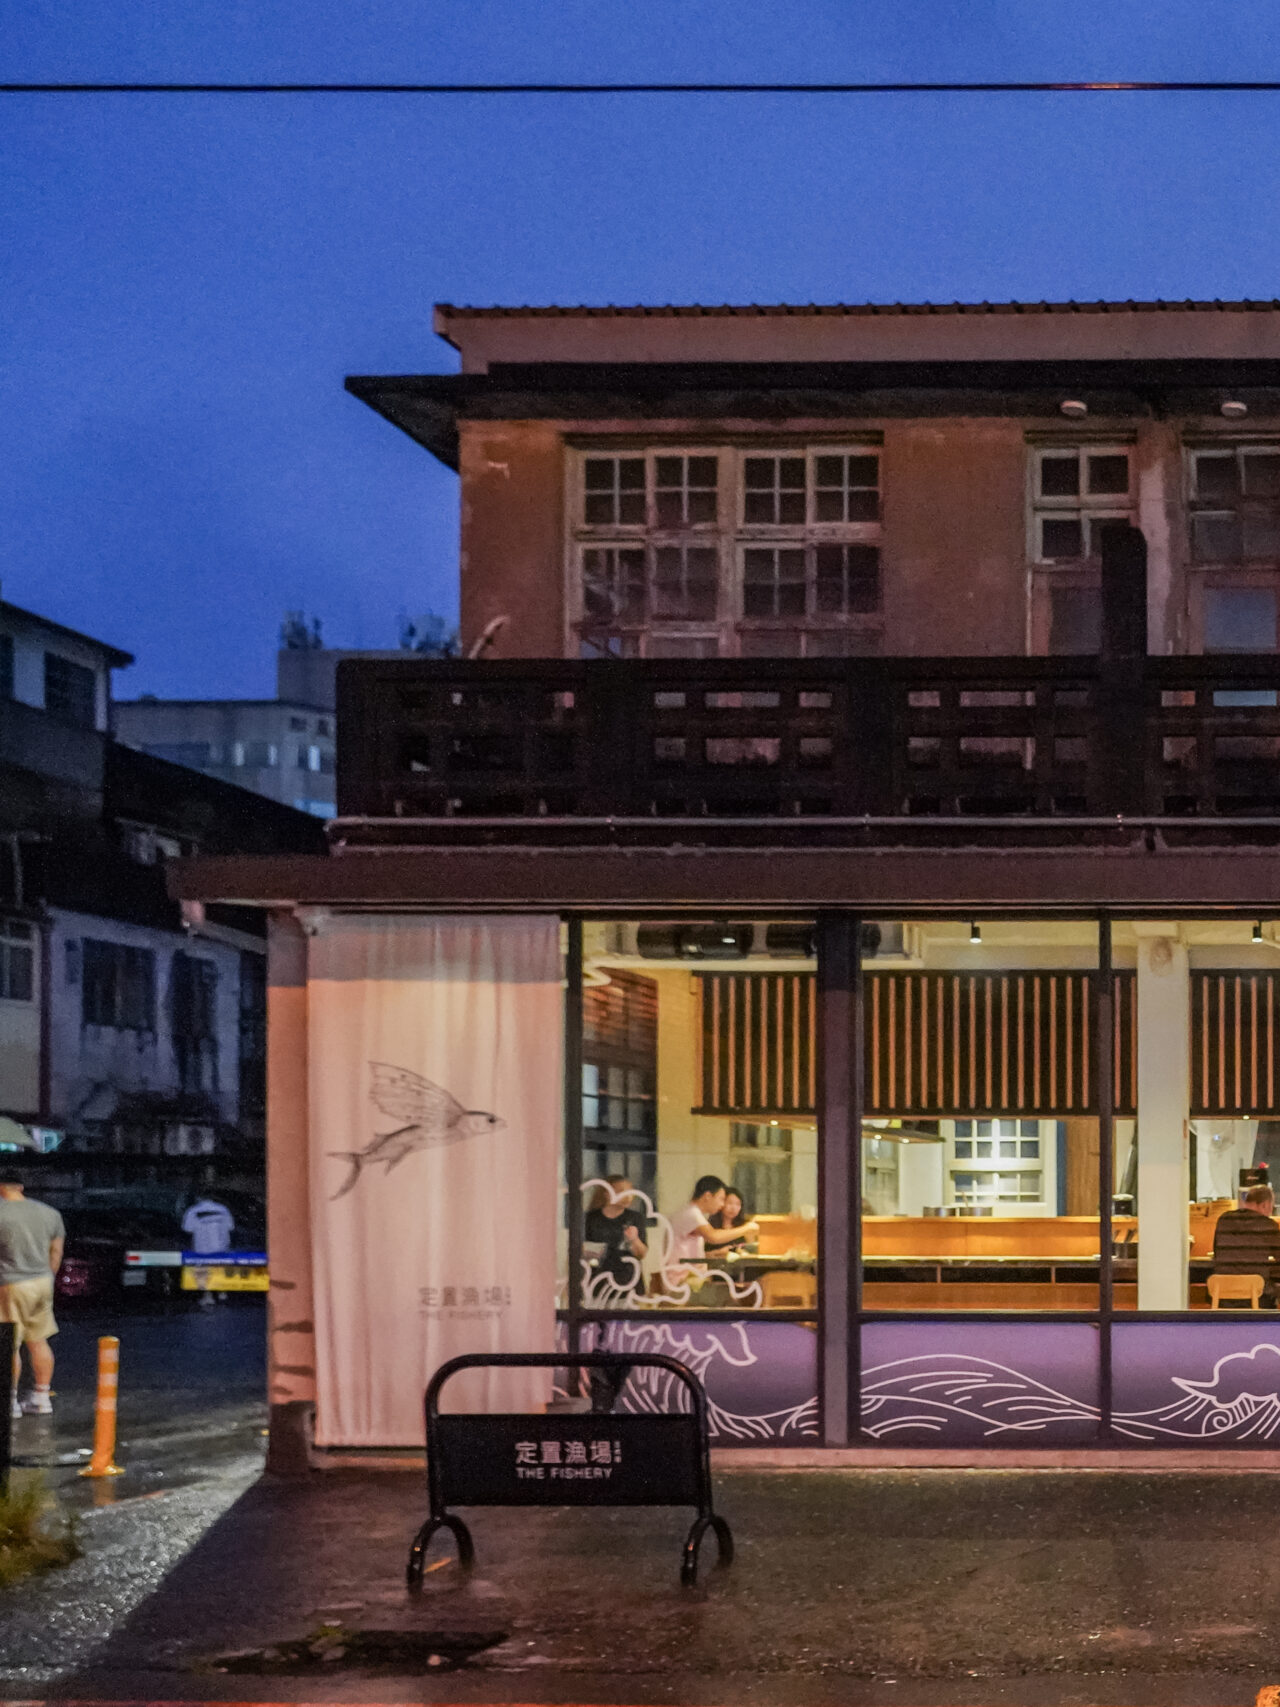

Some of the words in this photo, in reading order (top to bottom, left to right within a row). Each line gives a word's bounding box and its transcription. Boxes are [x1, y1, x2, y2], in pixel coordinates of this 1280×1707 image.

[515, 1441, 612, 1464] 定置漁場
[515, 1467, 545, 1479] THE
[550, 1467, 613, 1479] FISHERY
